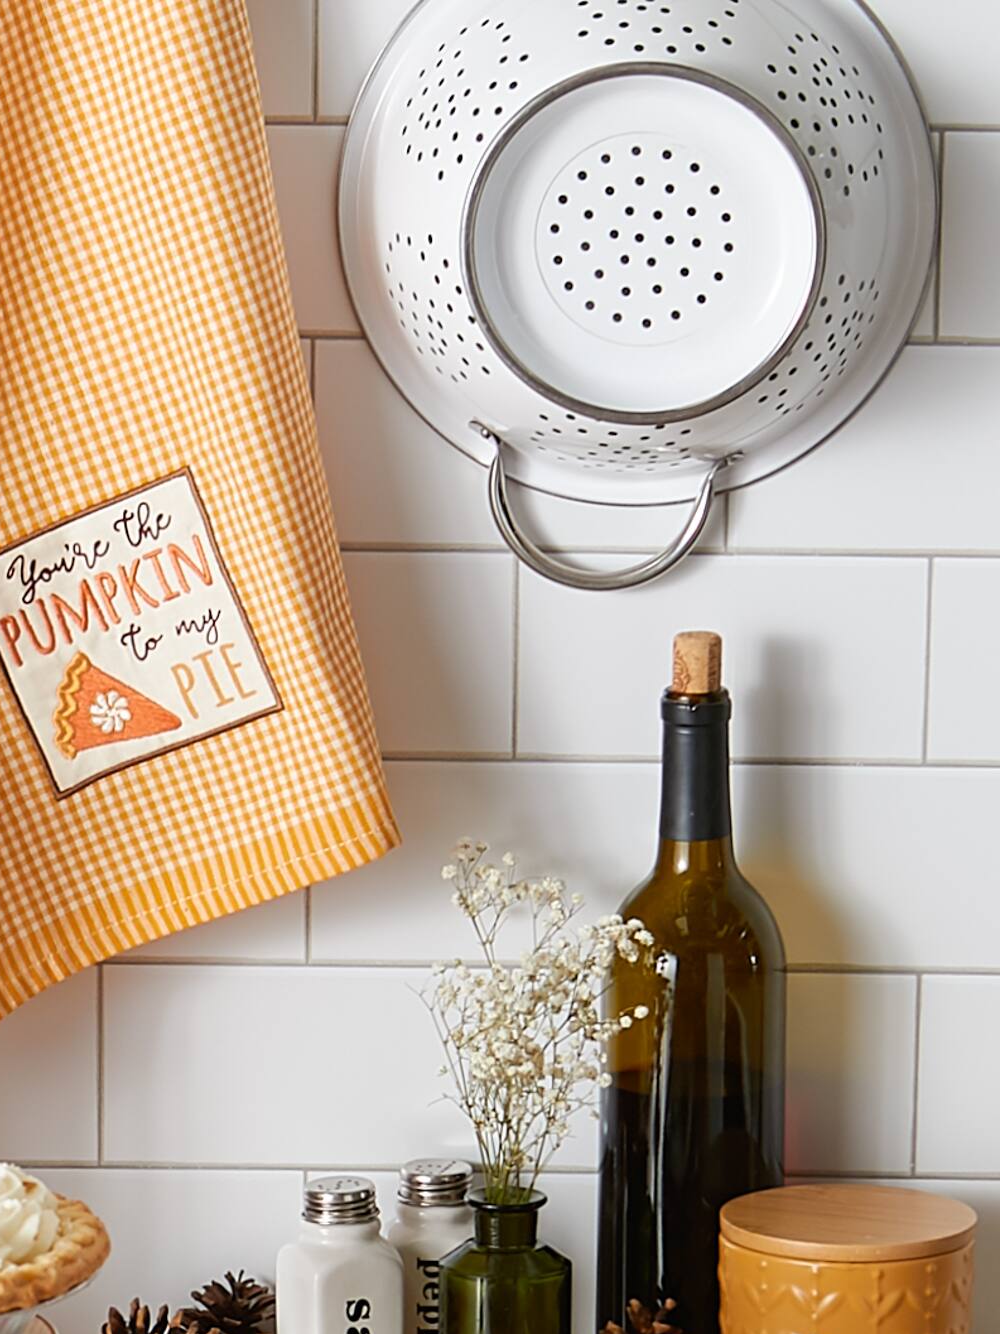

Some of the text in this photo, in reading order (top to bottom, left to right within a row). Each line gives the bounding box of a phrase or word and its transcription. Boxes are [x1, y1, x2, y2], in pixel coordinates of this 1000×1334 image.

[7, 502, 171, 604] You're the
[121, 608, 221, 661] to my
[170, 642, 257, 720] PIE
